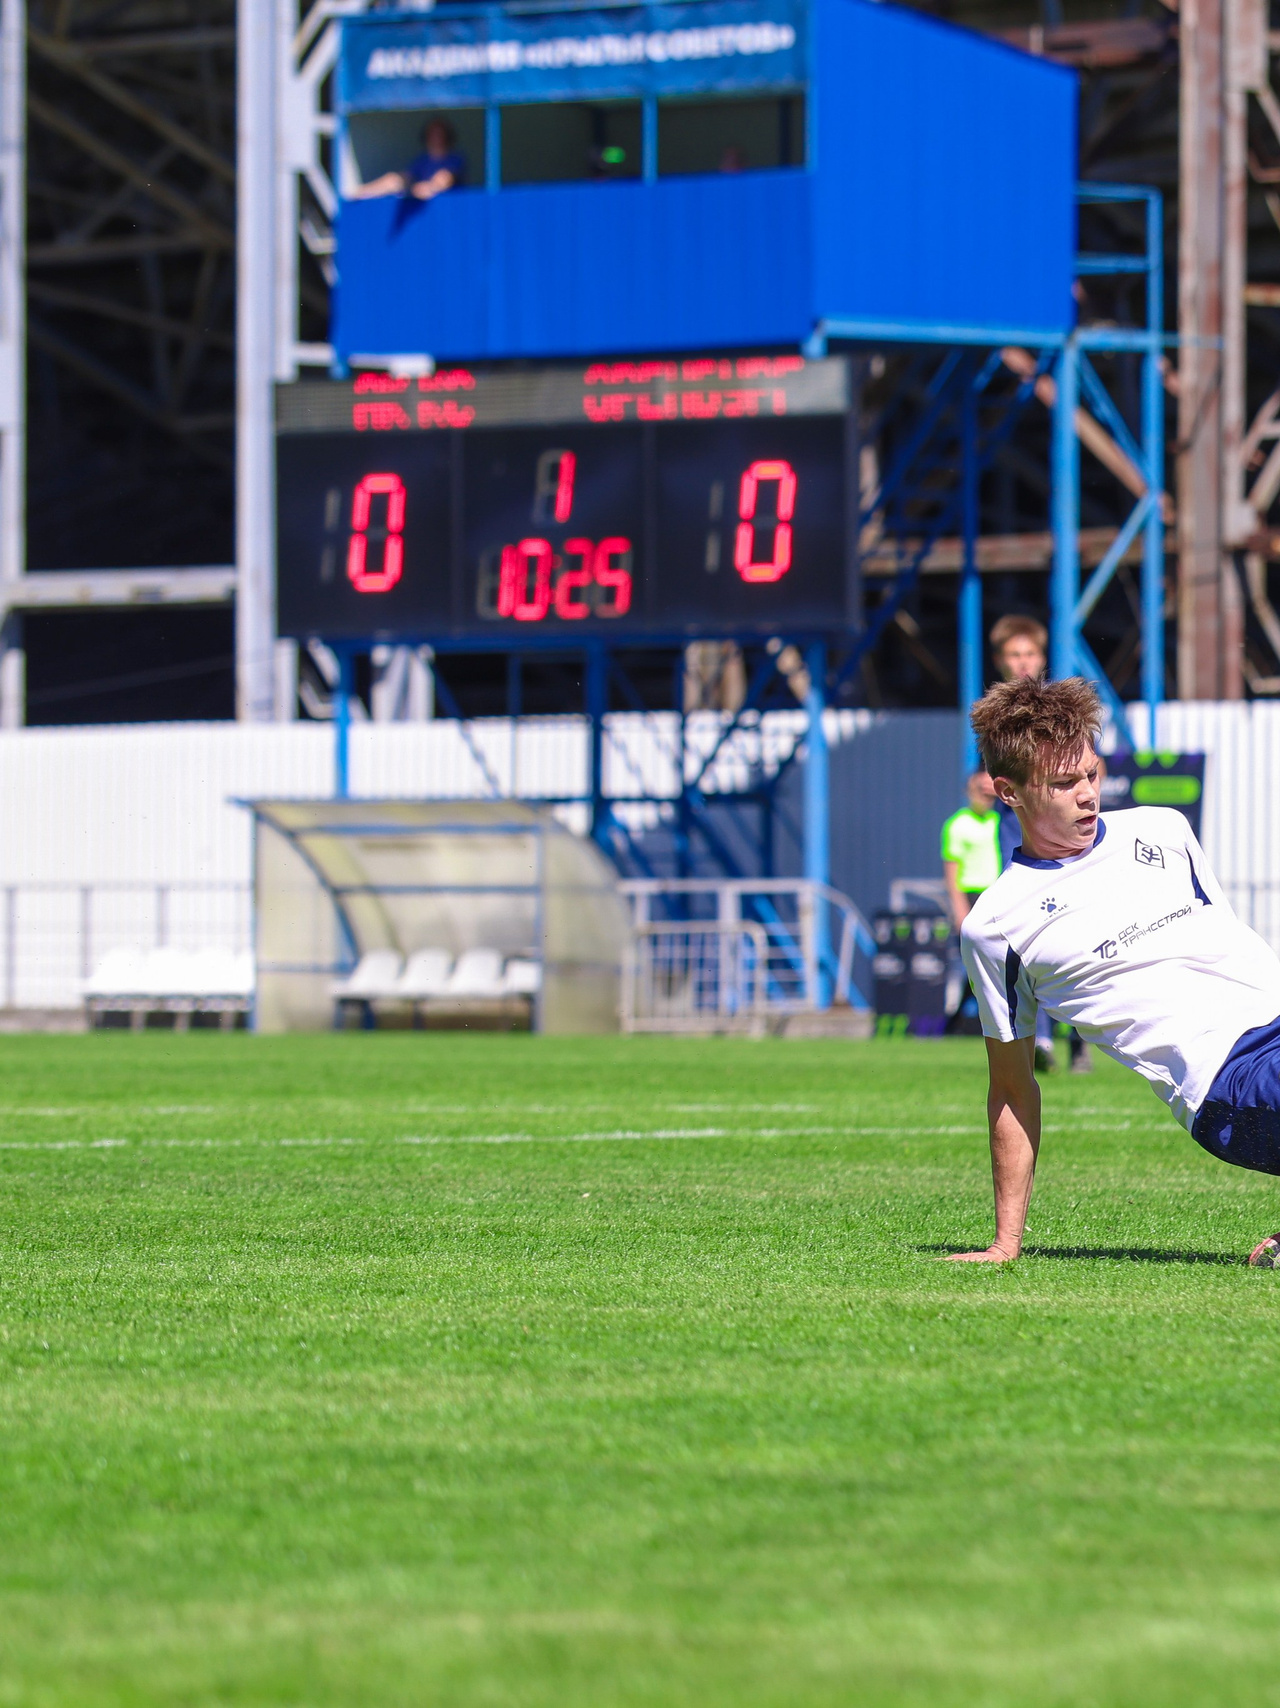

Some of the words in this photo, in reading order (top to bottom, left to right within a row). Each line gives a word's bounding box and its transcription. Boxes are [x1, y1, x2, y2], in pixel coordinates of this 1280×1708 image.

[347, 472, 408, 593] 0
[555, 450, 577, 523] 1
[734, 459, 798, 583] 0
[1122, 904, 1193, 948] ТРАНССТРОЙ
